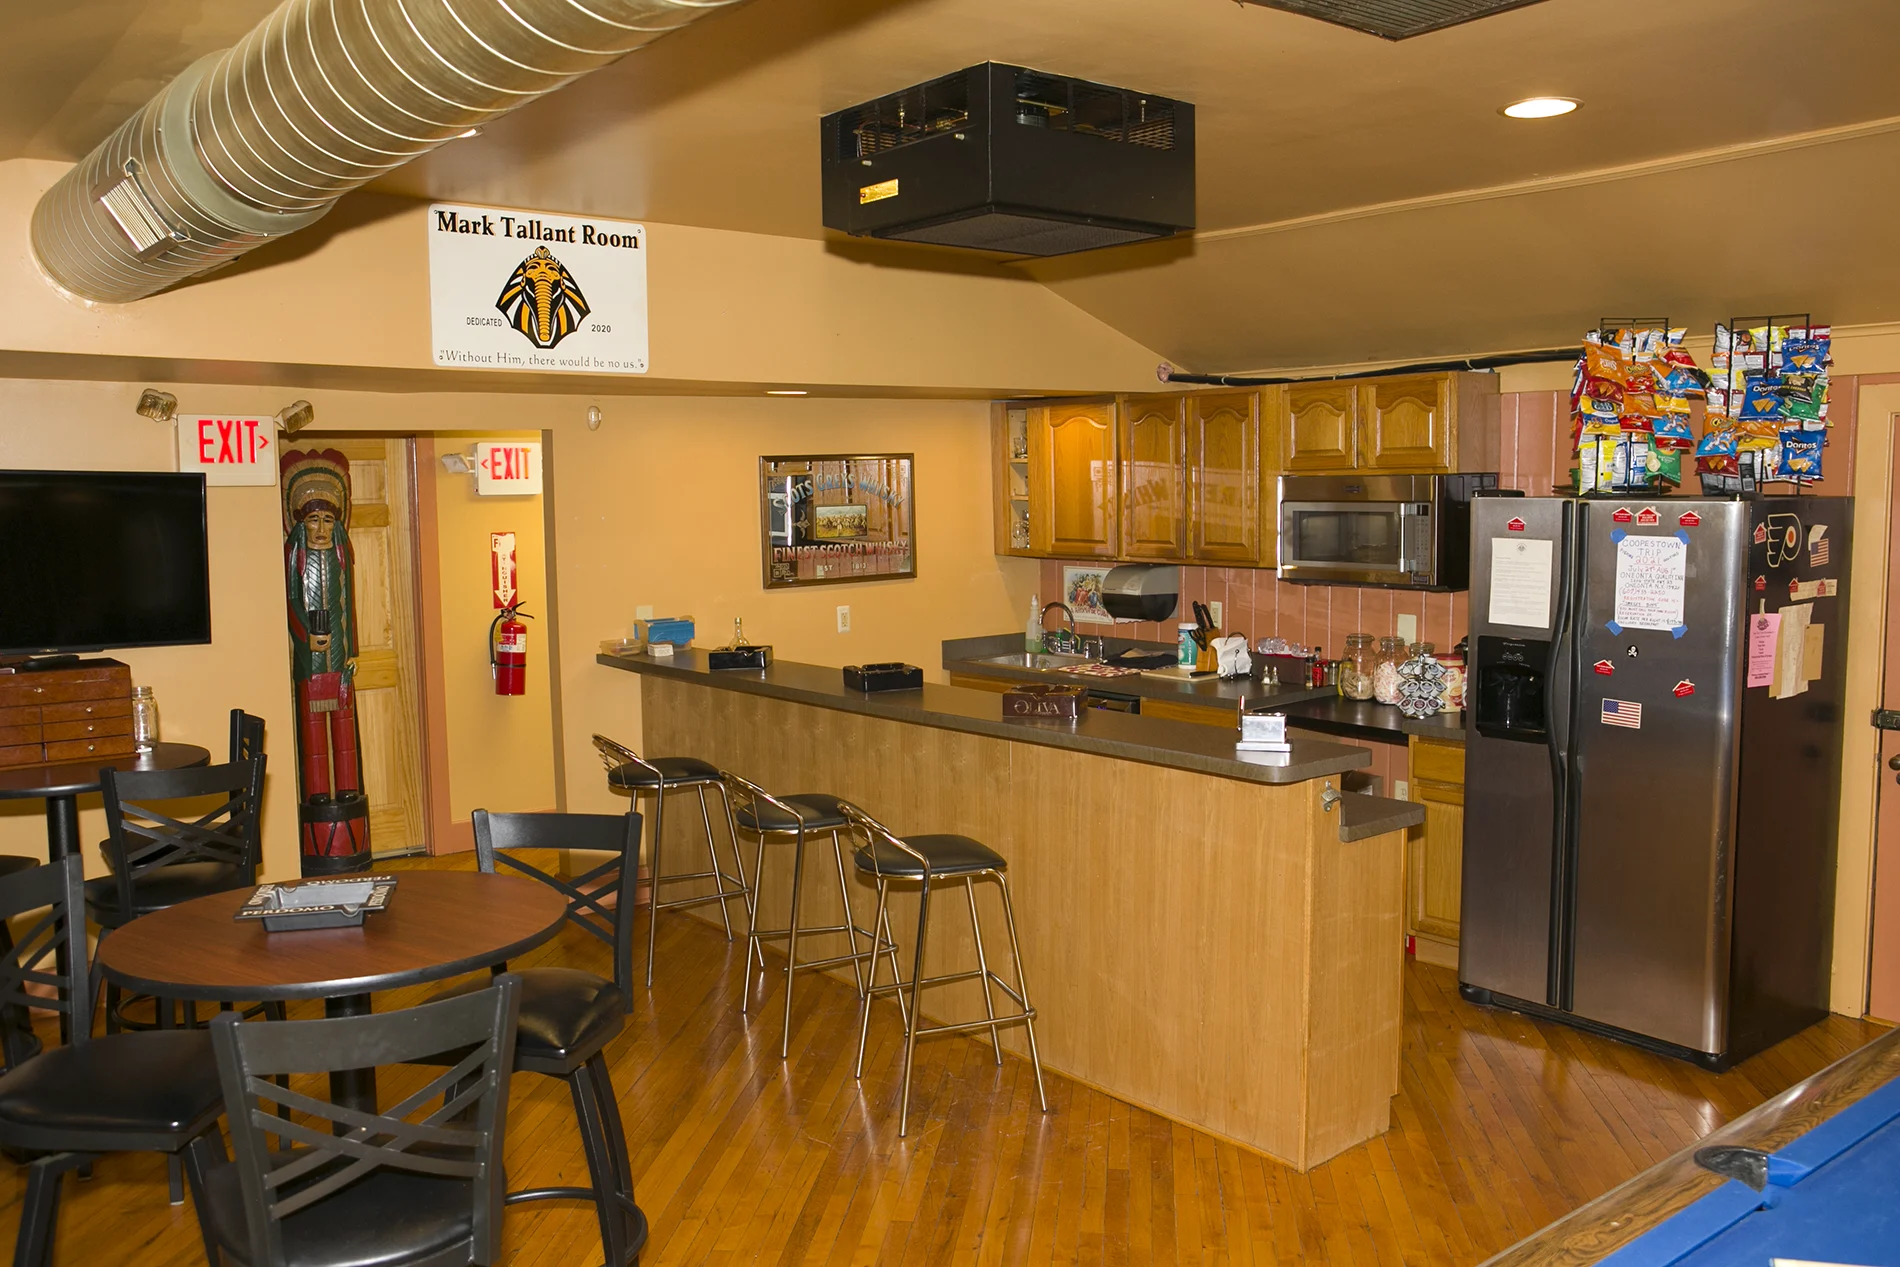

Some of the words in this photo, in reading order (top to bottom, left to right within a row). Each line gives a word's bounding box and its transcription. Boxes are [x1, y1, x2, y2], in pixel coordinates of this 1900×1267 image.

[437, 210, 496, 236] Mark
[500, 216, 576, 244] Tallant
[582, 224, 640, 250] Room
[466, 316, 503, 328] DEDICATED
[591, 323, 612, 334] 2020
[496, 352, 526, 366] Him,
[529, 354, 556, 366] there
[559, 355, 591, 368] would
[593, 356, 605, 368] be
[608, 360, 620, 369] no
[198, 419, 260, 464] EXIT
[1786, 440, 1817, 449] Doritos
[490, 447, 531, 480] EXIT
[772, 479, 814, 515] SCOTS
[859, 474, 905, 509] WHISKY
[773, 545, 819, 562] FINEST
[819, 543, 864, 559] SCOTCH
[865, 540, 909, 557] WHISKY
[1621, 540, 1681, 549] COOPESTOWN
[1637, 547, 1662, 557] TRIP
[1635, 555, 1661, 565] 2021
[1013, 699, 1061, 715] OLIVA
[241, 905, 335, 916] PERDOMO
